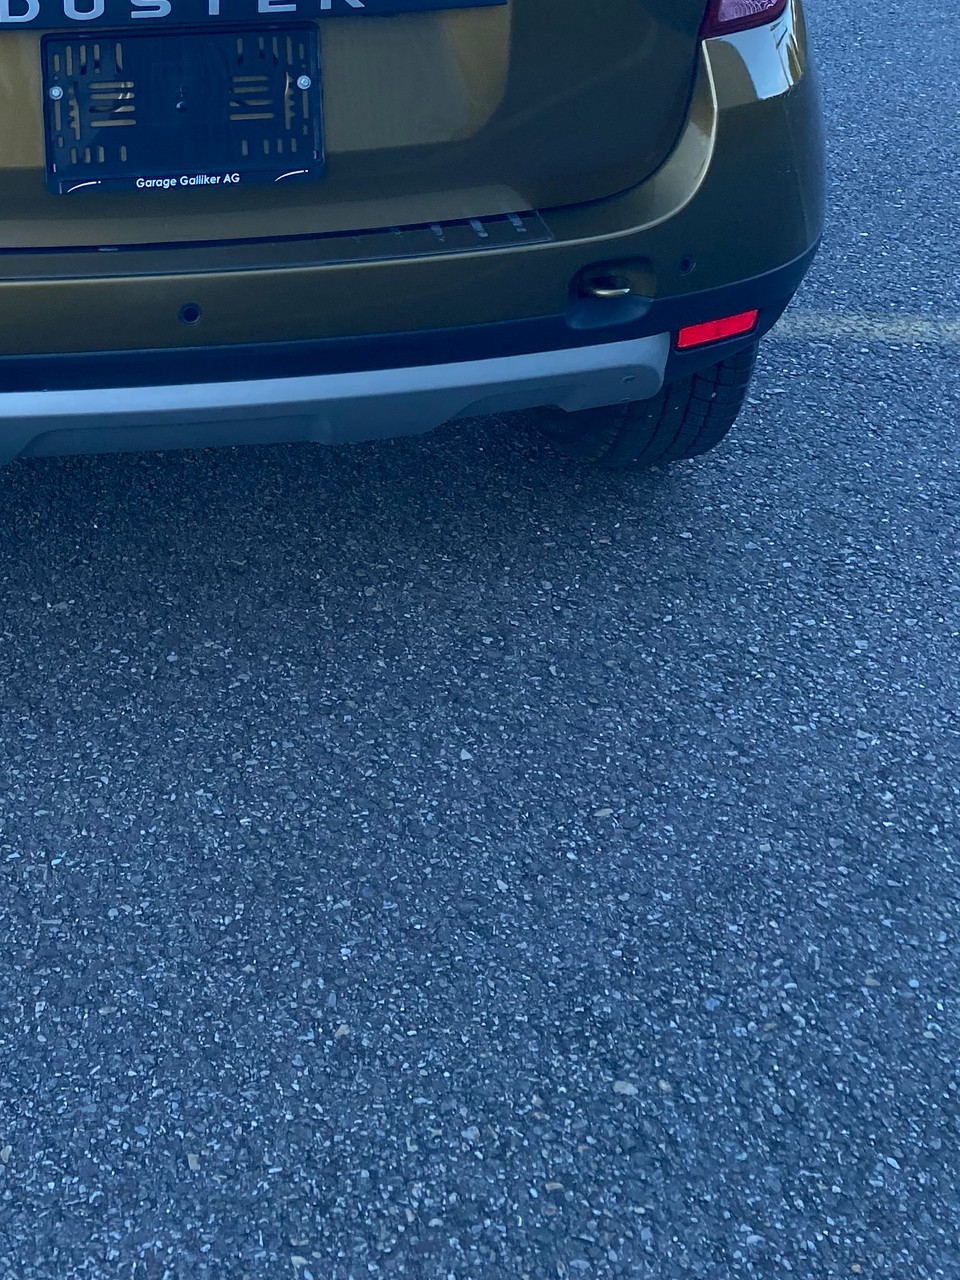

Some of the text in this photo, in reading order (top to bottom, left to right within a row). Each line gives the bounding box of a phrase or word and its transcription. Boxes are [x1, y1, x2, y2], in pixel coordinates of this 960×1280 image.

[136, 173, 240, 189] Garage Galliker AG
